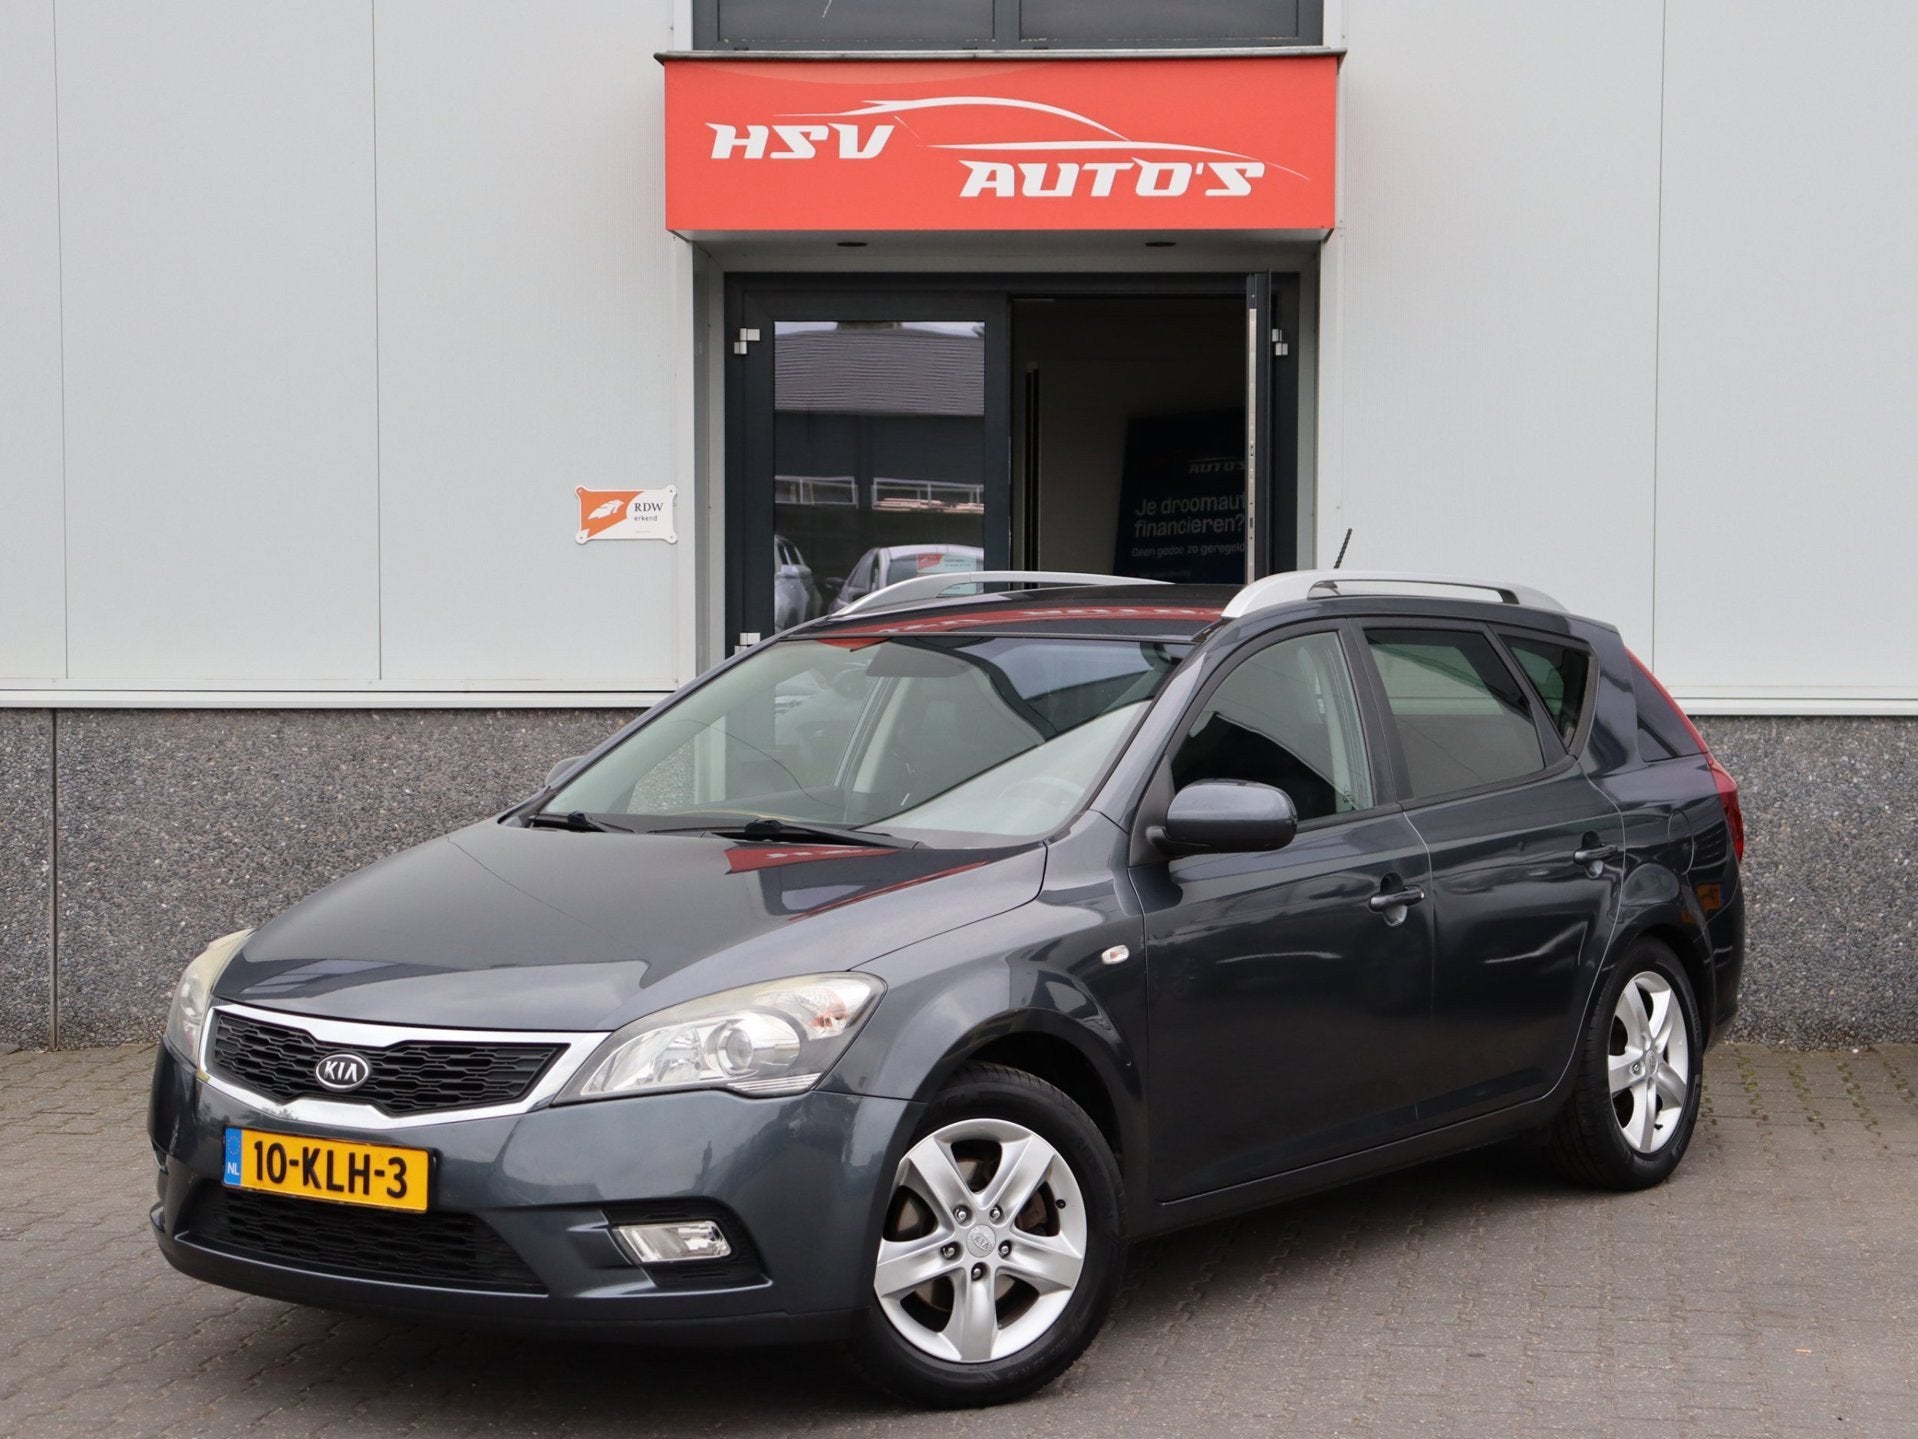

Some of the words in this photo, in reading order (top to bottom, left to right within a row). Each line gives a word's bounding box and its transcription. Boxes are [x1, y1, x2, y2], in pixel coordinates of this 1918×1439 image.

[704, 122, 895, 160] HSV
[958, 158, 1267, 198] AUTO'S
[634, 502, 664, 512] RDW
[1135, 498, 1157, 516] Je
[634, 514, 658, 522] erkend
[1134, 513, 1245, 537] financieren?
[324, 1061, 358, 1082] KIA
[227, 1161, 240, 1176] NL
[254, 1140, 408, 1199] 10-KLH-3
